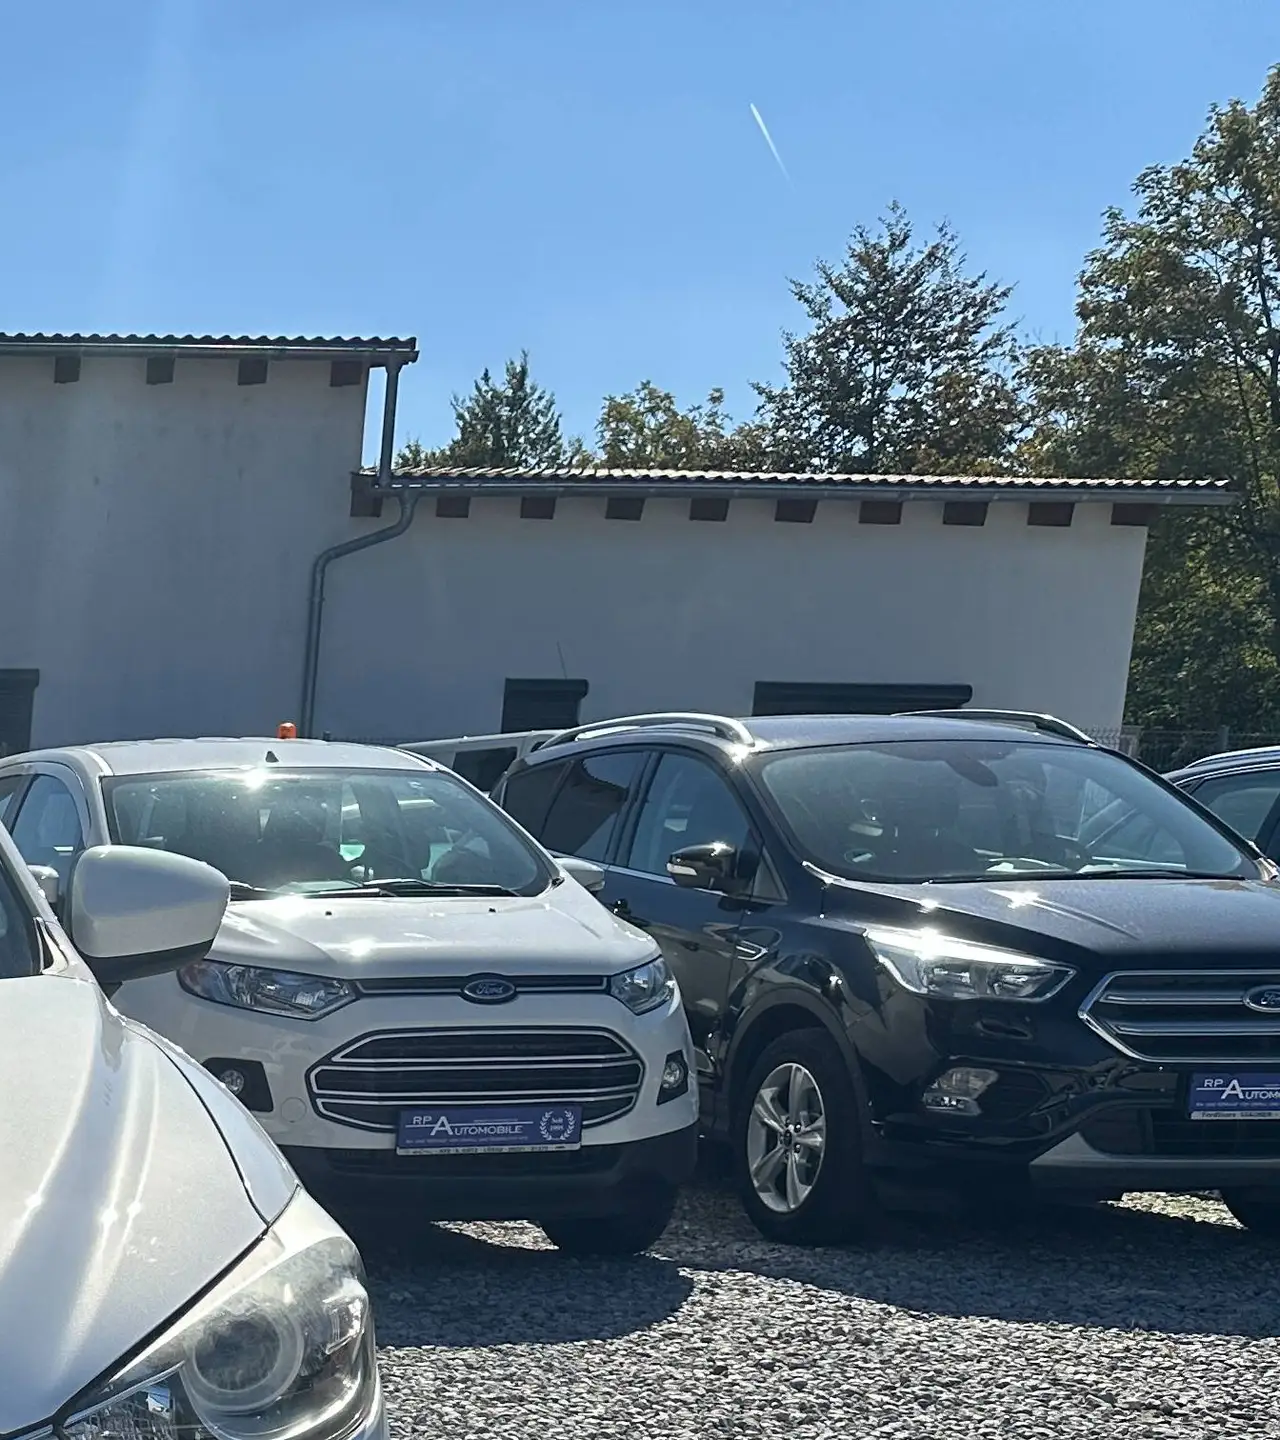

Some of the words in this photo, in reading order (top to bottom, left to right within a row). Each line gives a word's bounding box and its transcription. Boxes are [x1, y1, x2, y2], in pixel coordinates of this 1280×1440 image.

[1203, 1078, 1224, 1088] RP
[412, 1115, 433, 1125] RP
[430, 1115, 524, 1136] AUTOMOBILE
